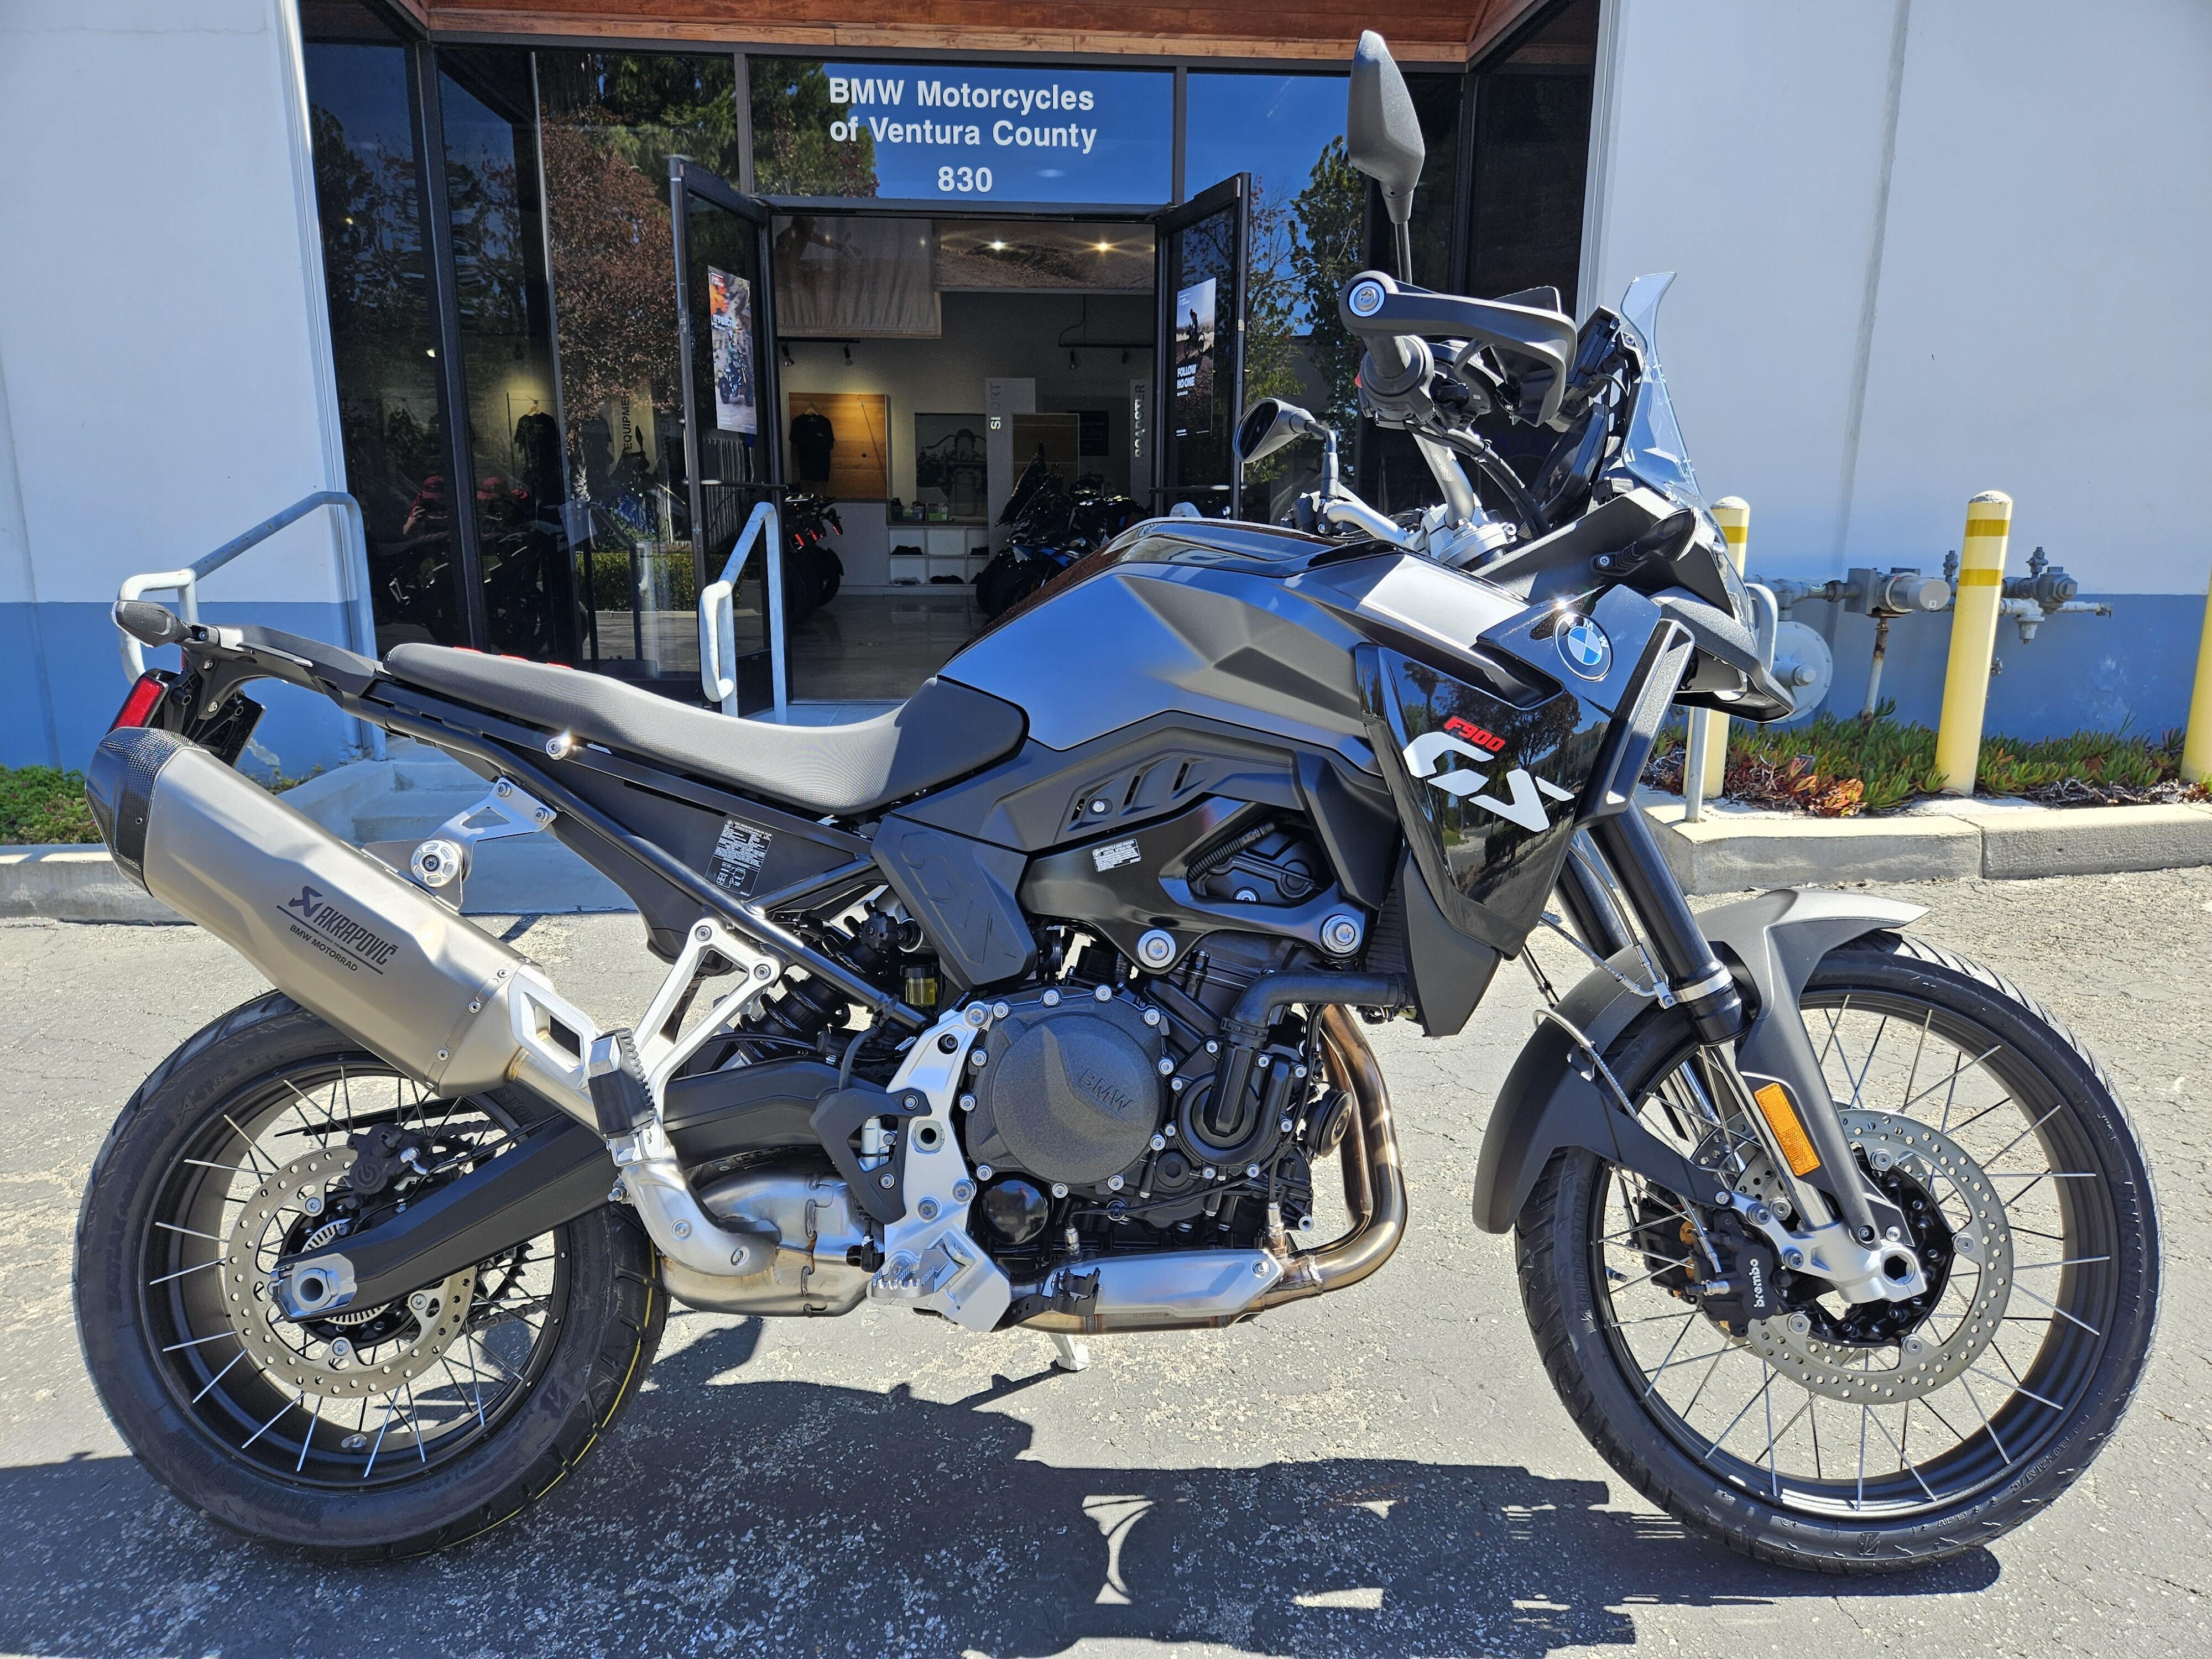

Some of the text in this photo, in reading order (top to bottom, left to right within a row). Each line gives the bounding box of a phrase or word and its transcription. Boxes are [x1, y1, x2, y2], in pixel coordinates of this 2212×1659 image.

[829, 77, 1094, 116] BMW Motorcycles
[830, 116, 1098, 155] of Ventura County
[937, 166, 993, 193] 830
[1176, 377, 1195, 389] NO ONE
[1177, 364, 1197, 378] FOLLOW
[1442, 715, 1506, 753] F900
[289, 924, 358, 972] BMW MOTORRAD
[1078, 1067, 1135, 1112] BMW
[1750, 1258, 1766, 1308] brembo
